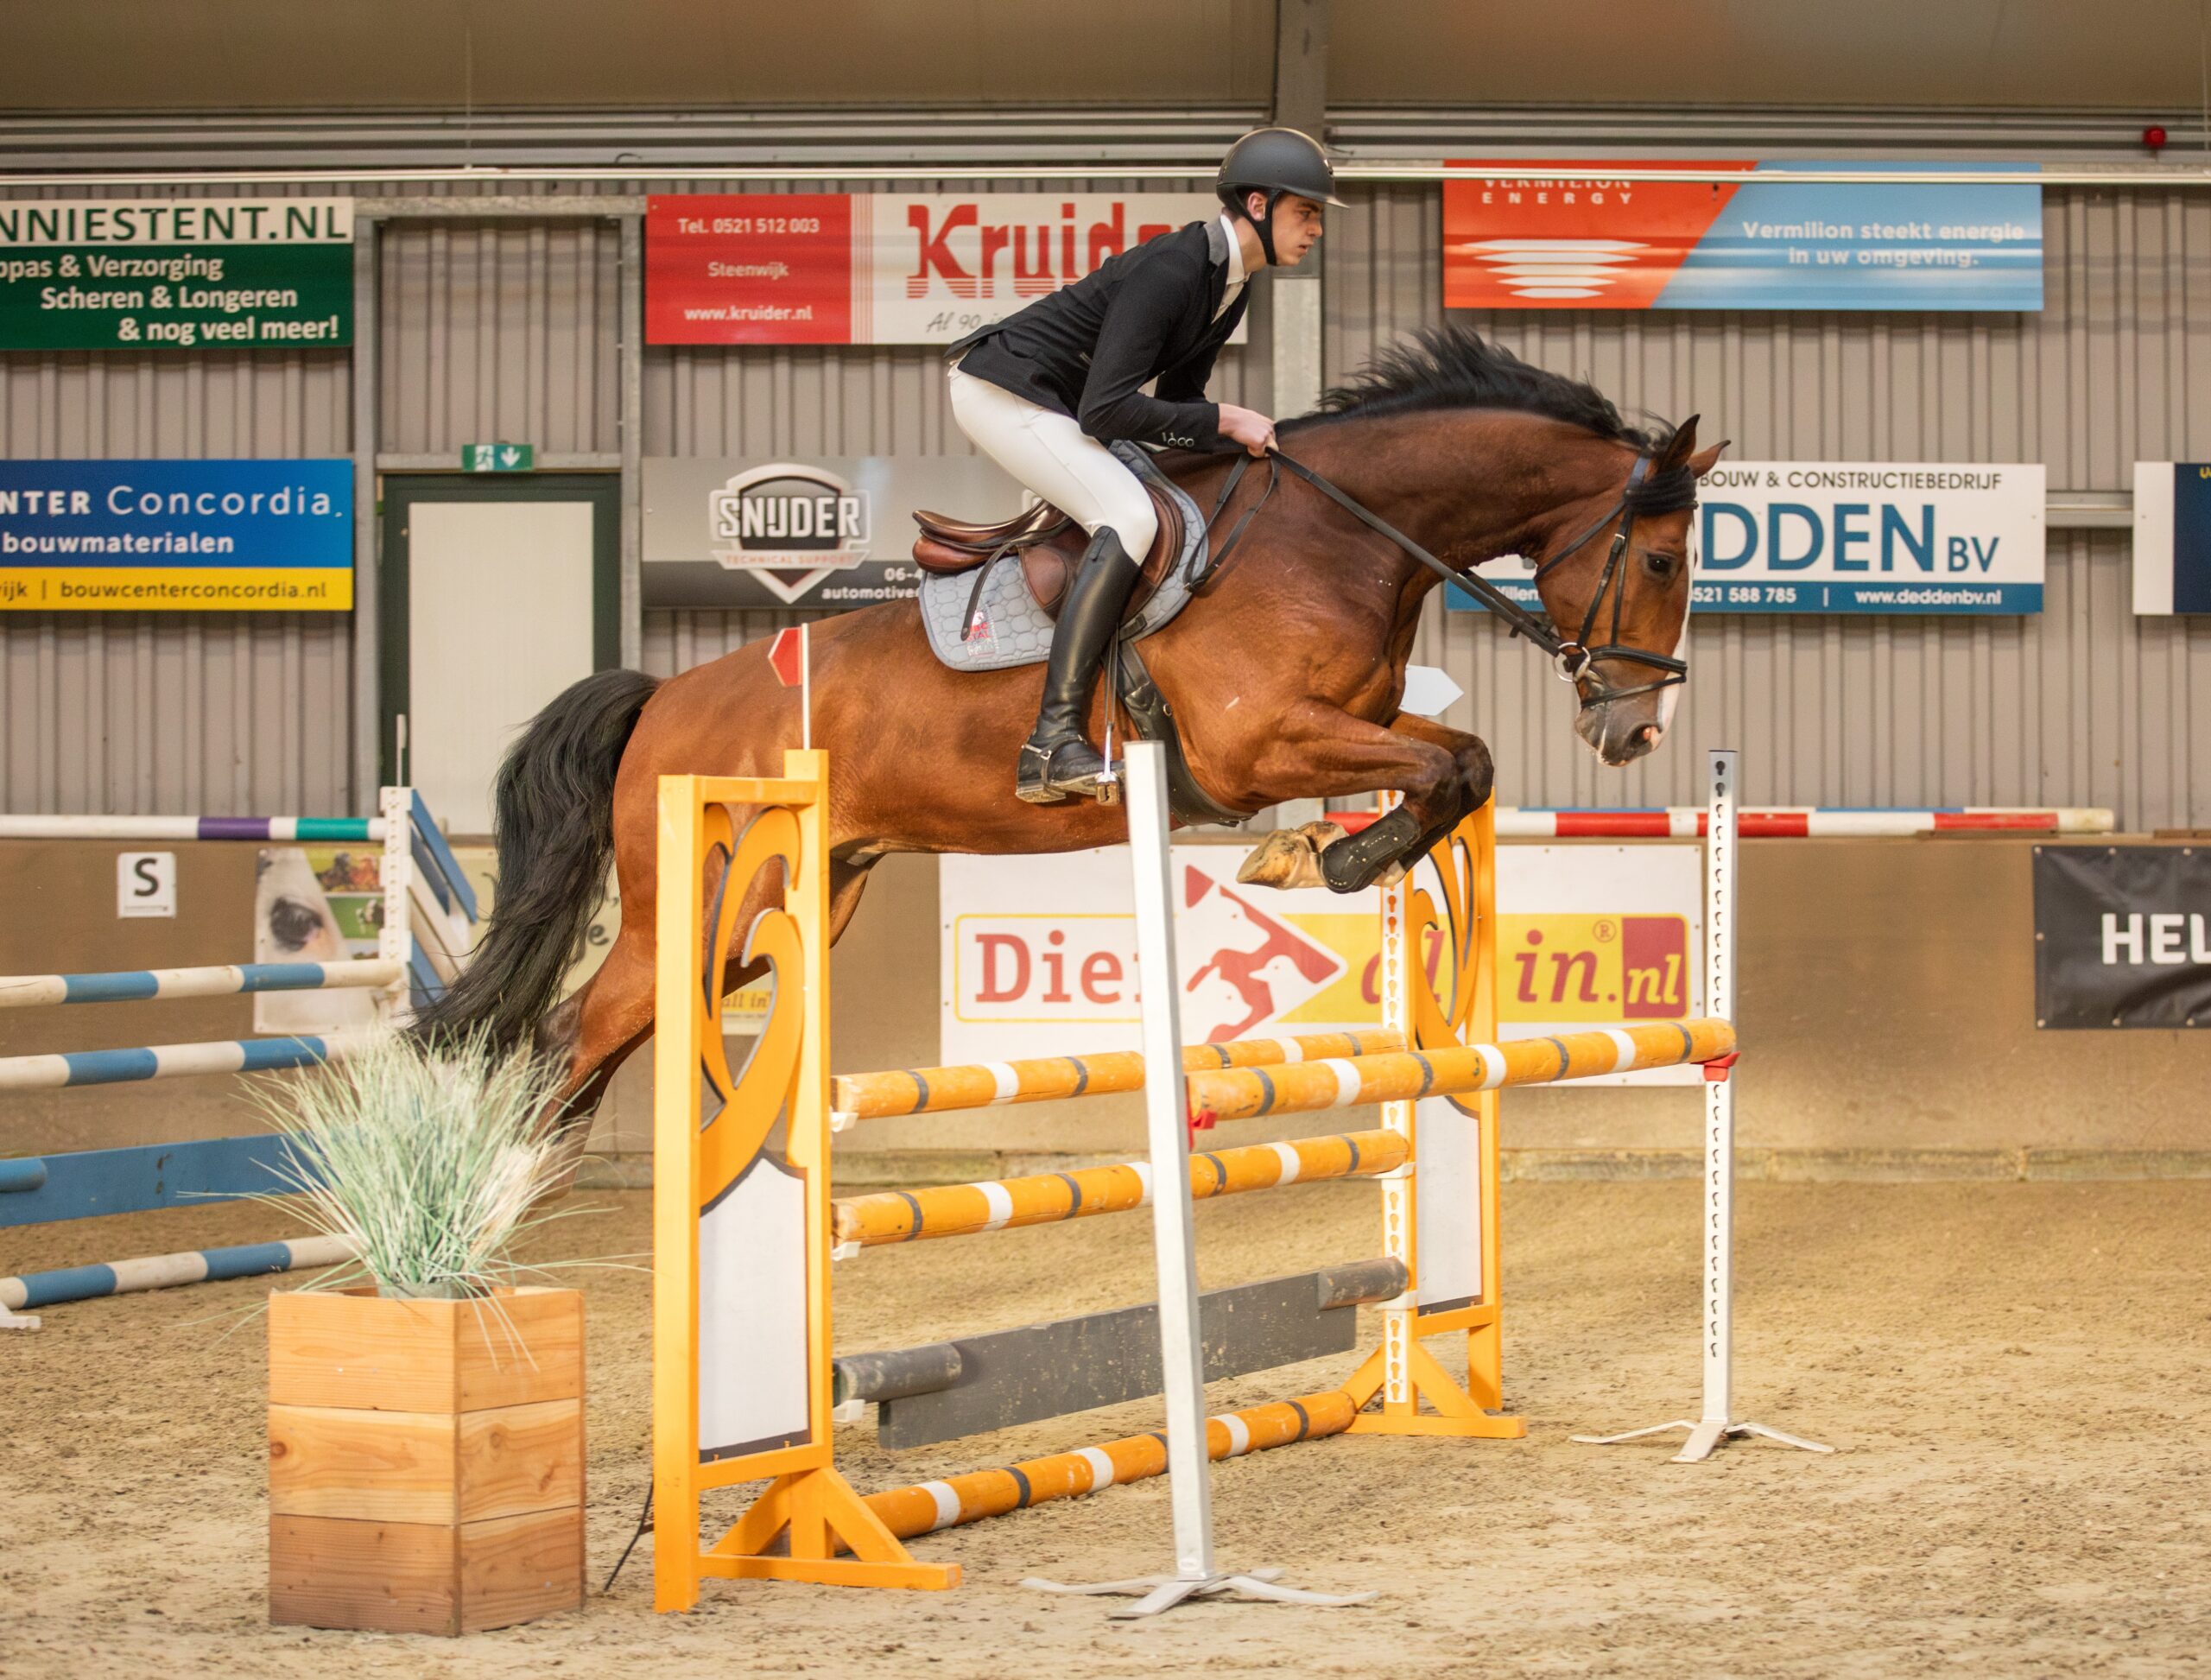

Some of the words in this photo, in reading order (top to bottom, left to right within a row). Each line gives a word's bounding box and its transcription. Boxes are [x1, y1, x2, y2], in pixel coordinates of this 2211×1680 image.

[1482, 192, 1631, 205] ENERGY
[713, 218, 752, 233] 0521
[757, 218, 786, 233] 512
[789, 218, 820, 233] 003
[1743, 221, 1853, 239] Vermilion
[1860, 222, 1932, 239] steekt
[1939, 223, 2024, 243] energie
[907, 202, 1186, 299] Kruid
[1789, 247, 1809, 264] in
[1816, 250, 1849, 264] uw
[1857, 248, 1980, 269] omgeving.
[59, 255, 81, 277] &
[87, 254, 224, 282] Verzorging
[707, 262, 789, 281] Steenwijk
[41, 286, 144, 309] Scheren
[150, 286, 172, 309] &
[179, 286, 298, 313] Longeren
[684, 305, 814, 321] www.kruider.nl
[117, 317, 140, 340] &
[147, 323, 195, 346] nog
[201, 316, 255, 340] veel
[262, 314, 339, 339] meer!
[1766, 471, 1781, 489] &
[1787, 471, 2002, 490] CONSTRUCTIEBEDRIJF
[3, 531, 234, 554] bouwmaterialen
[1701, 502, 1935, 573] DDEN
[1948, 536, 2000, 573] BV
[725, 554, 793, 565] TECHNICAL
[799, 554, 853, 565] SUPPORT
[60, 580, 327, 598] bouwcenterconcordia.nl
[1728, 586, 1761, 603] 588
[1765, 586, 1796, 603] 785
[1855, 586, 2002, 605] www.deddenbv.nl
[134, 858, 159, 897] S
[975, 929, 1142, 1004] Die
